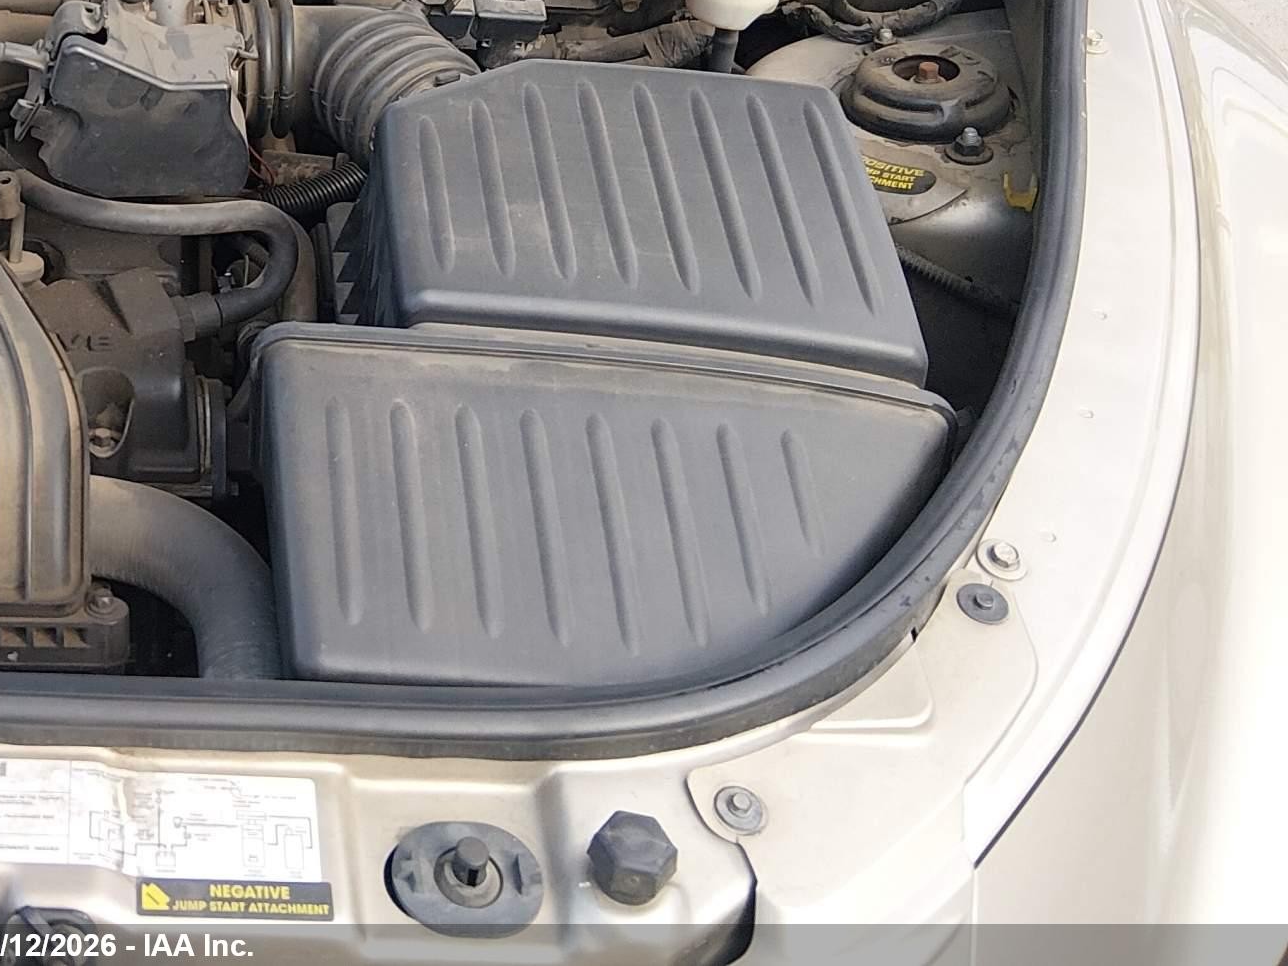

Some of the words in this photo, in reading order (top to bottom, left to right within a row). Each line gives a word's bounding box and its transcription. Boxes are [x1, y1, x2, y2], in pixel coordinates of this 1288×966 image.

[882, 172, 917, 182] START
[209, 884, 291, 900] NEGATIVE
[172, 899, 208, 912] JUMP
[209, 900, 247, 913] START
[248, 902, 330, 916] ATTACHMENT
